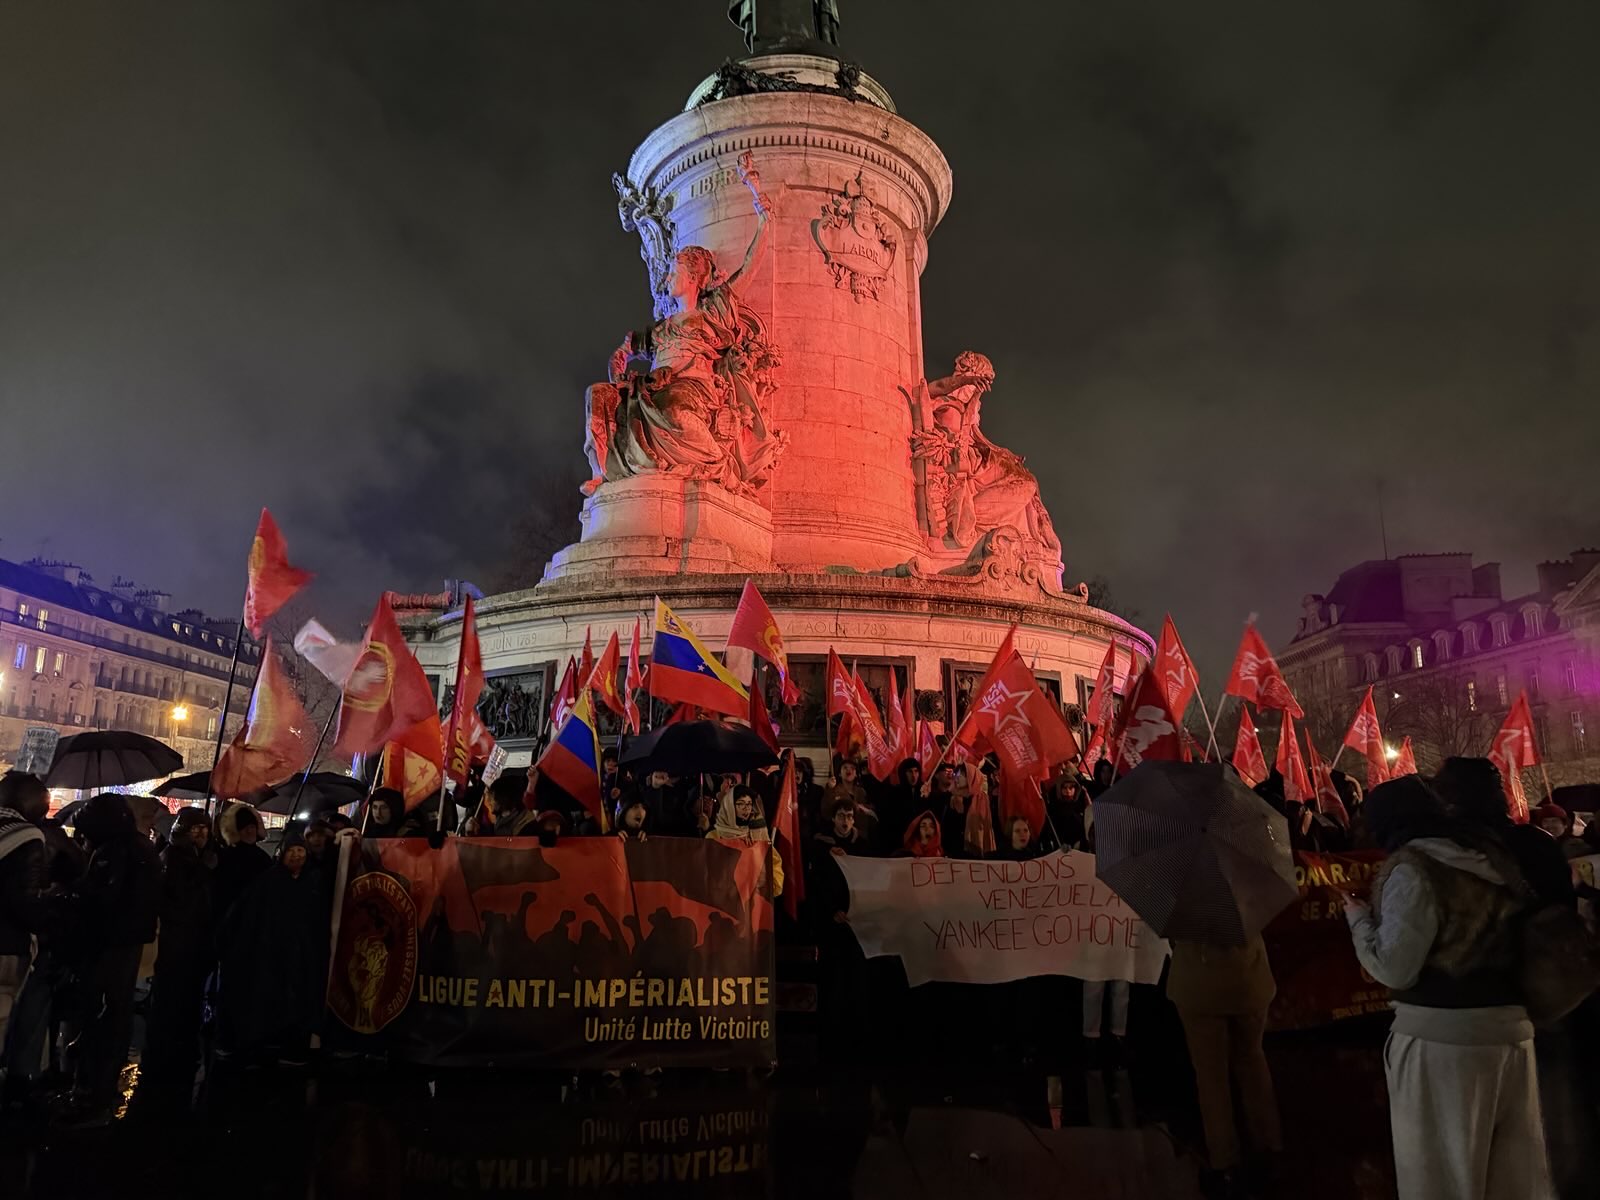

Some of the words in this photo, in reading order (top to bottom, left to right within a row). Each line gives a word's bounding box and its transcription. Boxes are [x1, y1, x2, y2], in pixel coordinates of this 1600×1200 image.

[842, 242, 879, 264] LABOR
[978, 884, 1121, 910] VENEZUELA
[923, 918, 1027, 951] YANKEE
[1031, 914, 1073, 947] GO
[1075, 914, 1145, 950] HOME
[418, 973, 478, 1007] LIGUE
[485, 970, 769, 1008] ANTI-IMPÉRIALISTE
[584, 1016, 636, 1043] Unité
[642, 1017, 692, 1041] Lutte
[699, 1016, 769, 1040] Victoire
